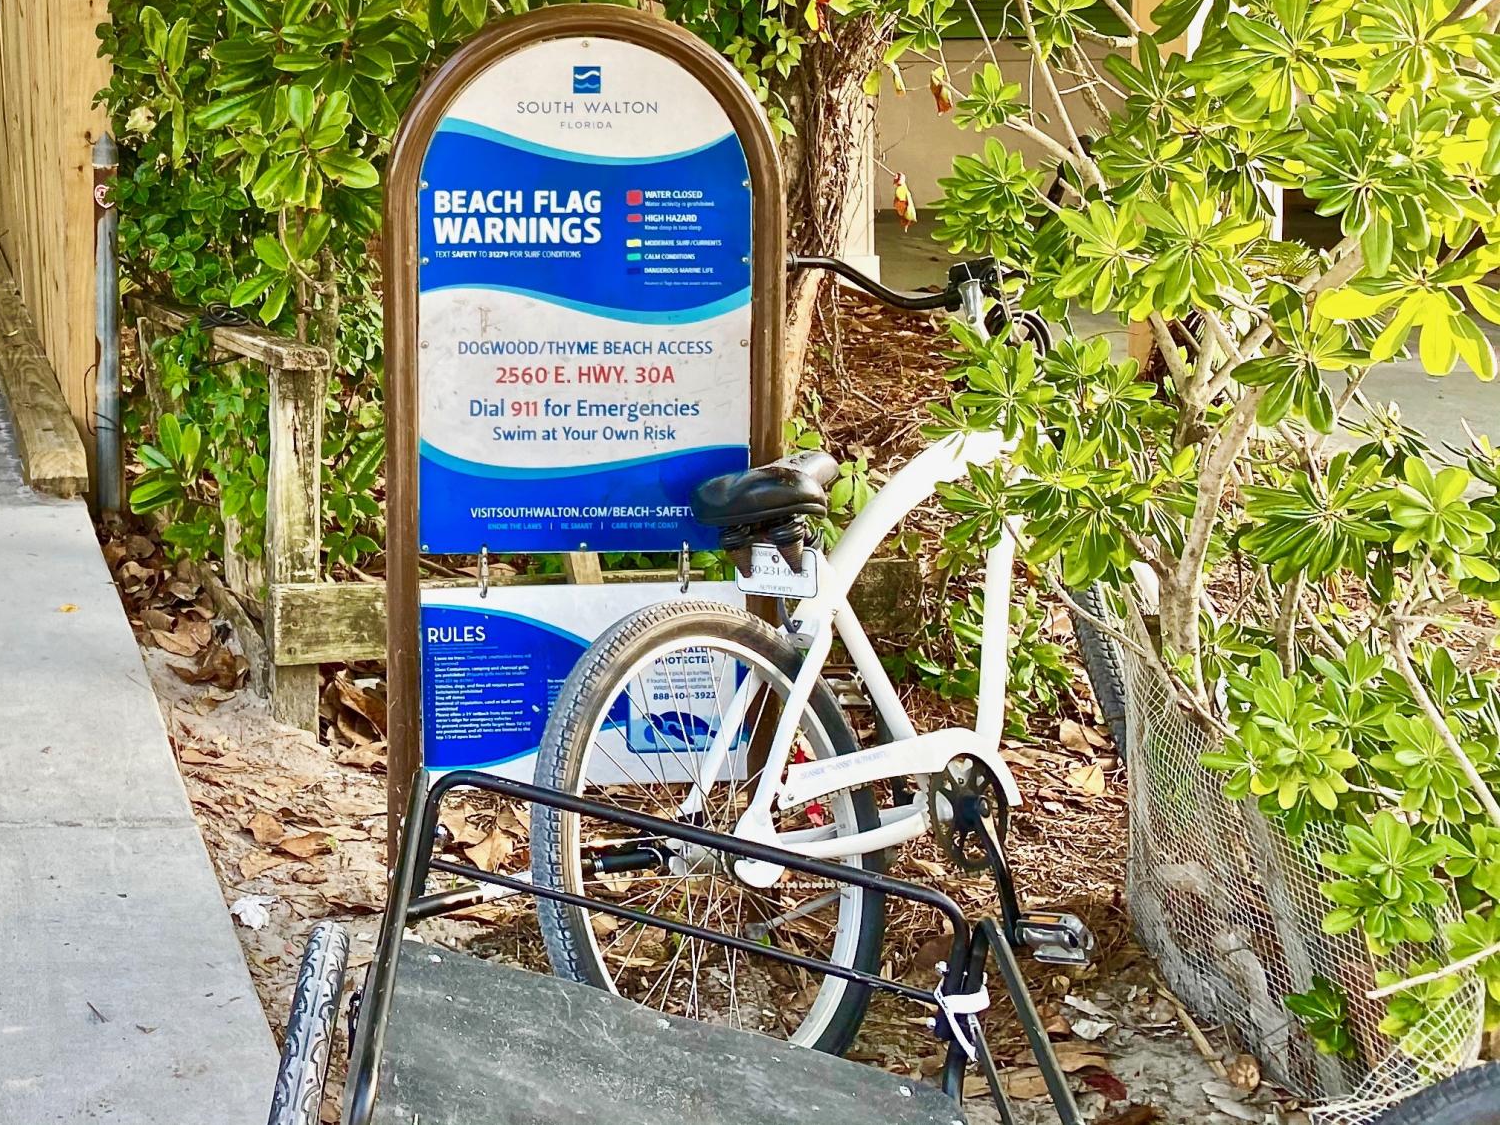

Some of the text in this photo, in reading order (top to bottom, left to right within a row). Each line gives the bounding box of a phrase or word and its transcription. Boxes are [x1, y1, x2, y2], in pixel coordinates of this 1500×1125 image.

[516, 101, 658, 114] SOUTH WALTON
[560, 121, 613, 129] FLORIDA
[644, 190, 703, 198] WATER CLOSED
[434, 190, 601, 214] BEACH FLAG
[644, 214, 698, 223] HIGH HAZARD
[433, 217, 602, 244] WARNINGS
[435, 250, 450, 258] TEXT
[452, 250, 477, 258] SAFETY
[509, 250, 523, 258] FOR
[524, 250, 541, 258] SURF
[542, 250, 581, 258] CONDITIONS
[458, 341, 713, 355] DOGWOOD/THYME BEACH ACCESS
[495, 366, 675, 384] 2560 E. HWY. 30A
[469, 398, 700, 421] Dial 911 for Emergencies
[492, 425, 676, 441] Swim at Your Own Risk
[427, 626, 486, 644] RULES
